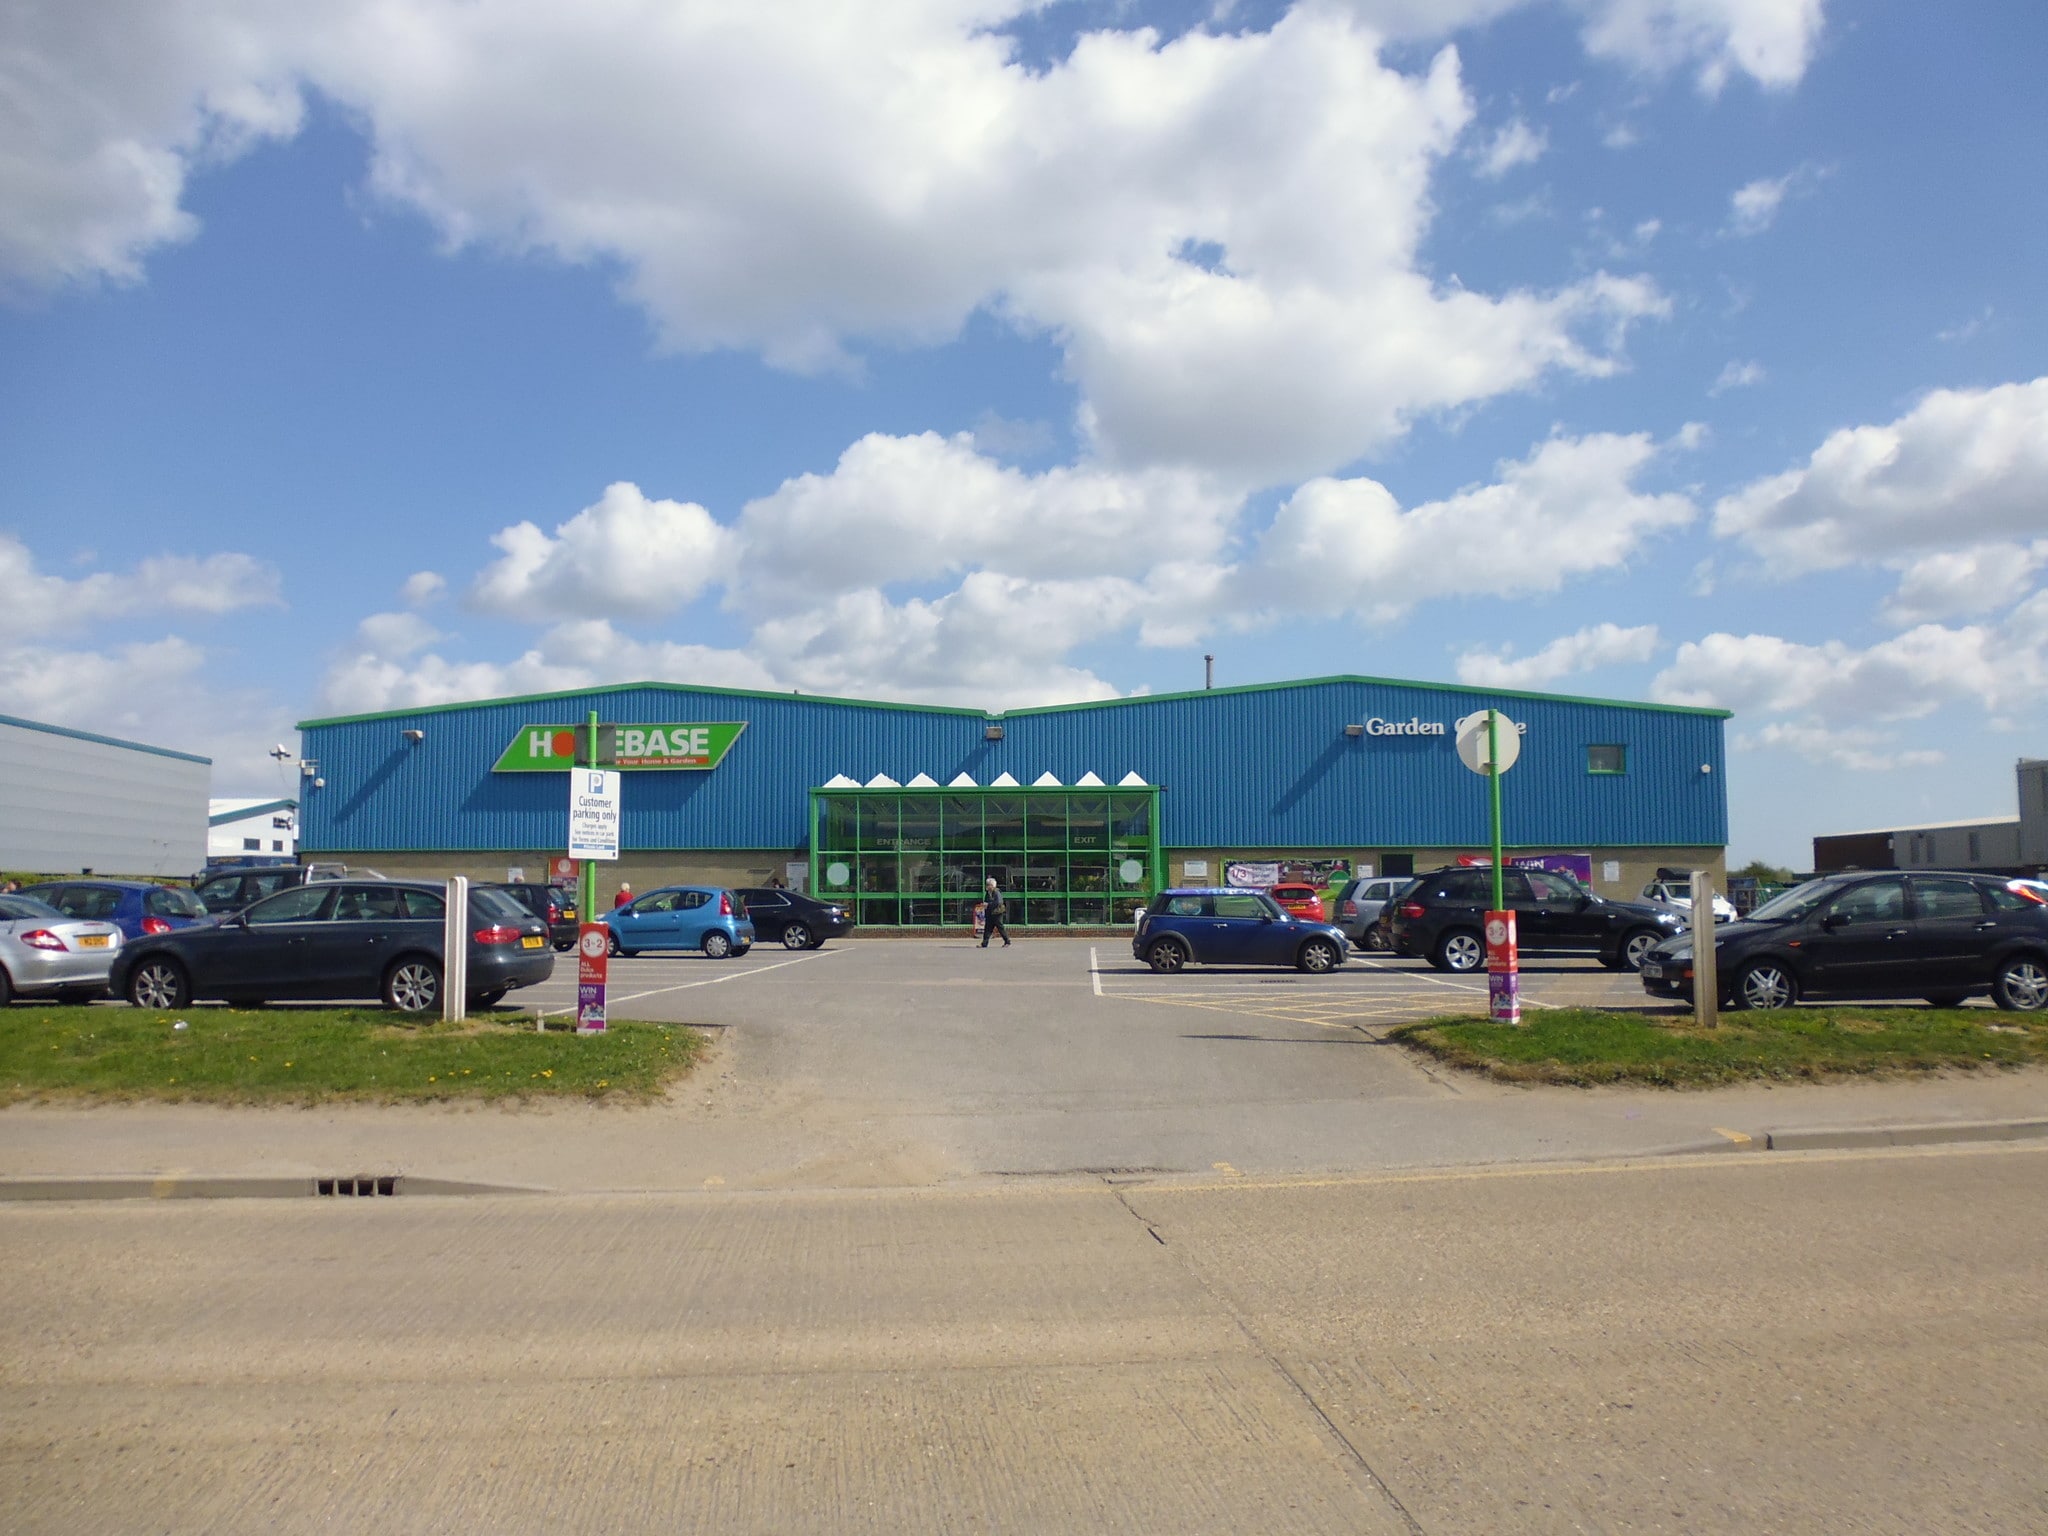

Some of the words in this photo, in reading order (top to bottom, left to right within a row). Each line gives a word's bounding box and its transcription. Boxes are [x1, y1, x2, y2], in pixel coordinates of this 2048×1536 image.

[1366, 717, 1445, 736] Garden
[529, 728, 709, 757] HOEBASE
[670, 757, 697, 765] Garden
[579, 796, 612, 808] Customer
[573, 809, 600, 822] parking
[602, 811, 617, 823] only
[1074, 836, 1096, 844] EXIT
[1231, 869, 1246, 878] 1/3
[1489, 927, 1495, 937] 3
[1499, 927, 1505, 937] 2
[584, 938, 590, 948] 3
[596, 938, 602, 948] 2
